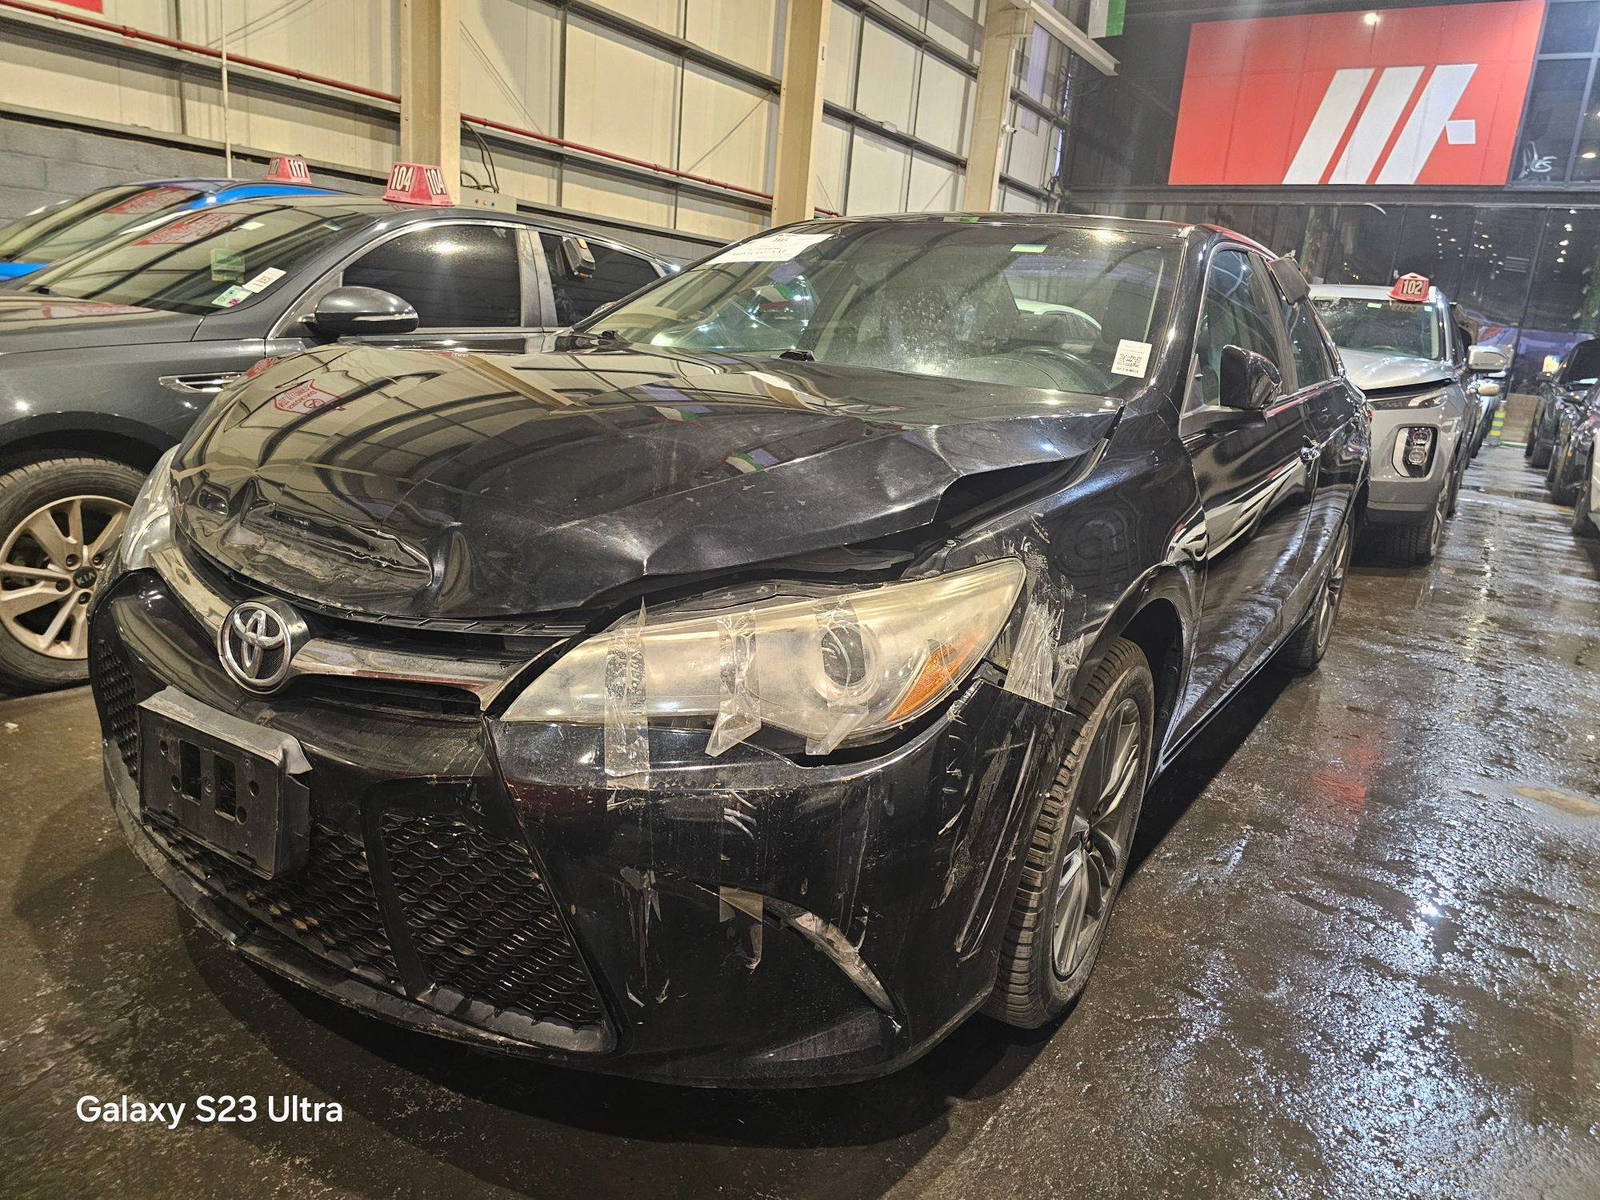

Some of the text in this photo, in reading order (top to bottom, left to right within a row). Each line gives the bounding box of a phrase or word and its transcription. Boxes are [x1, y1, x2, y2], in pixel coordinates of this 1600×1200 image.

[390, 165, 414, 192] 104
[426, 168, 447, 195] 104
[1402, 279, 1424, 296] 102
